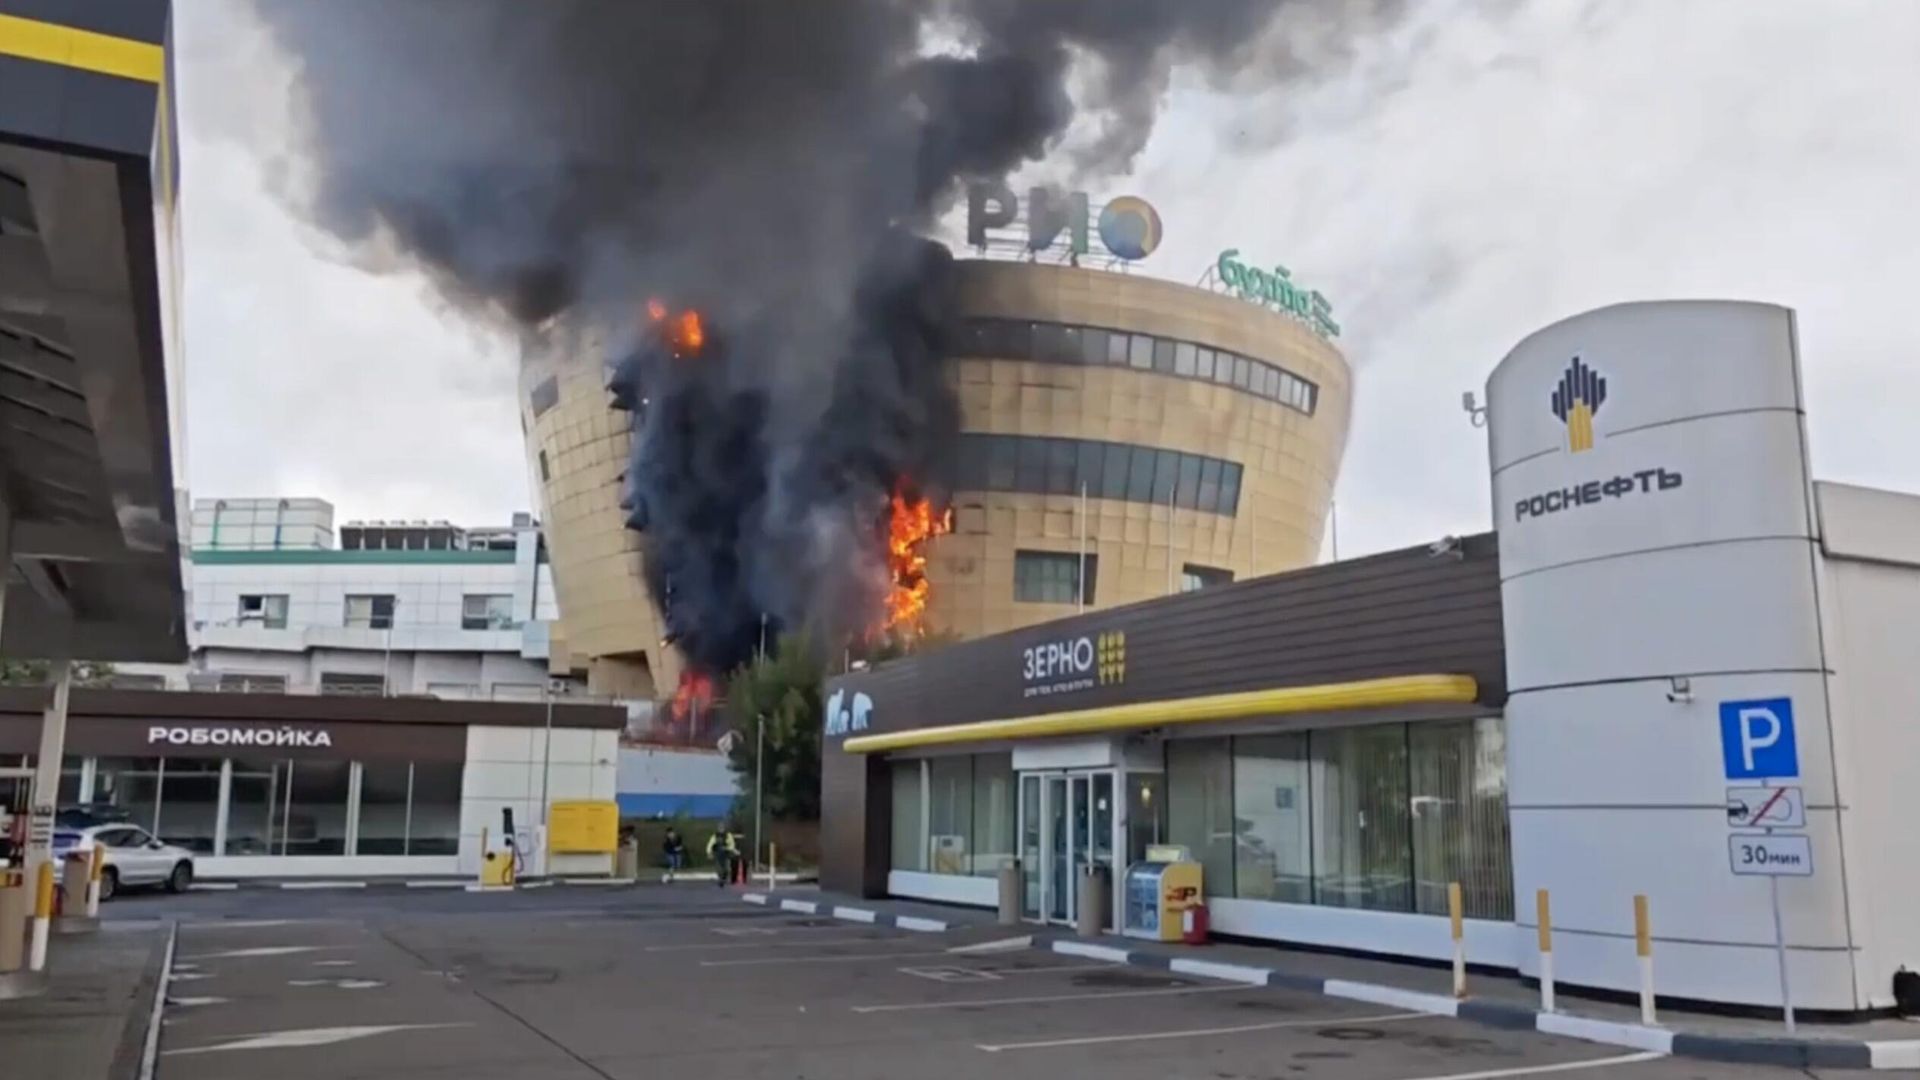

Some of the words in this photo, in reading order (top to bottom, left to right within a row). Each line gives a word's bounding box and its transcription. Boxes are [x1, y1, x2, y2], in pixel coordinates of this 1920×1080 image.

[967, 180, 1163, 260] РИО
[1515, 467, 1682, 522] РОСНЕФТЬ
[1023, 637, 1093, 680] ЗЕРНО
[148, 726, 332, 747] РОБОМОЙКА
[1739, 708, 1781, 771] P
